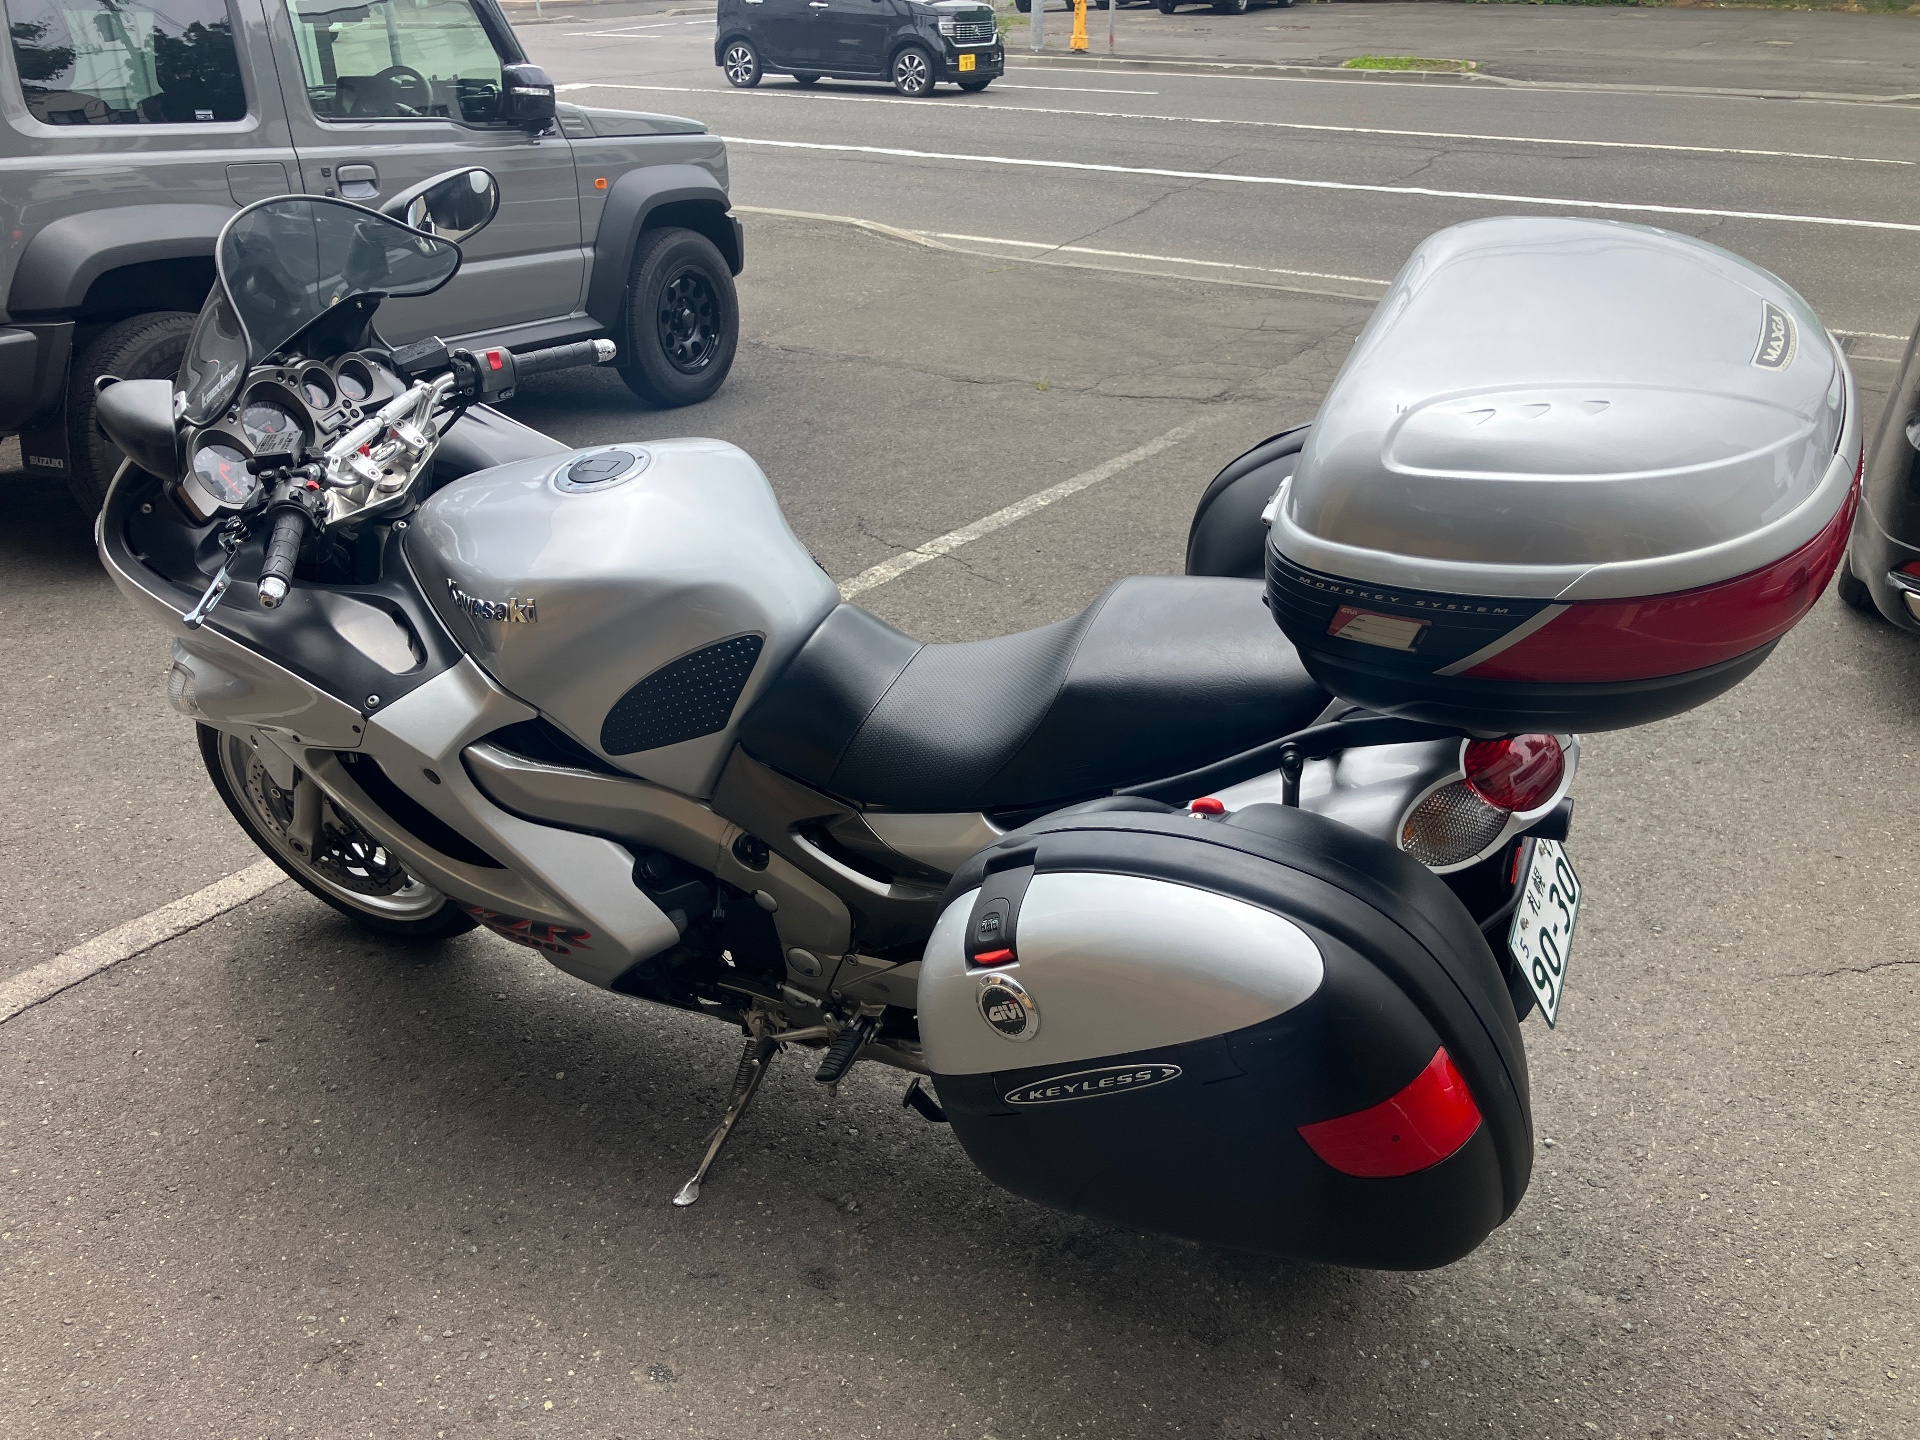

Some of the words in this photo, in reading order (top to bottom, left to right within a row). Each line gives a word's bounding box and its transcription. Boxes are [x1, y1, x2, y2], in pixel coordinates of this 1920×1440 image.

[29, 455, 64, 469] SUZUKI
[446, 578, 537, 623] Kawasaki
[1298, 576, 1401, 603] MONOKEY
[1415, 599, 1510, 614] SYSTEM
[1531, 856, 1576, 1010] 90-30
[988, 1002, 1025, 1022] GIVI
[1028, 1069, 1152, 1101] KEYLESS
